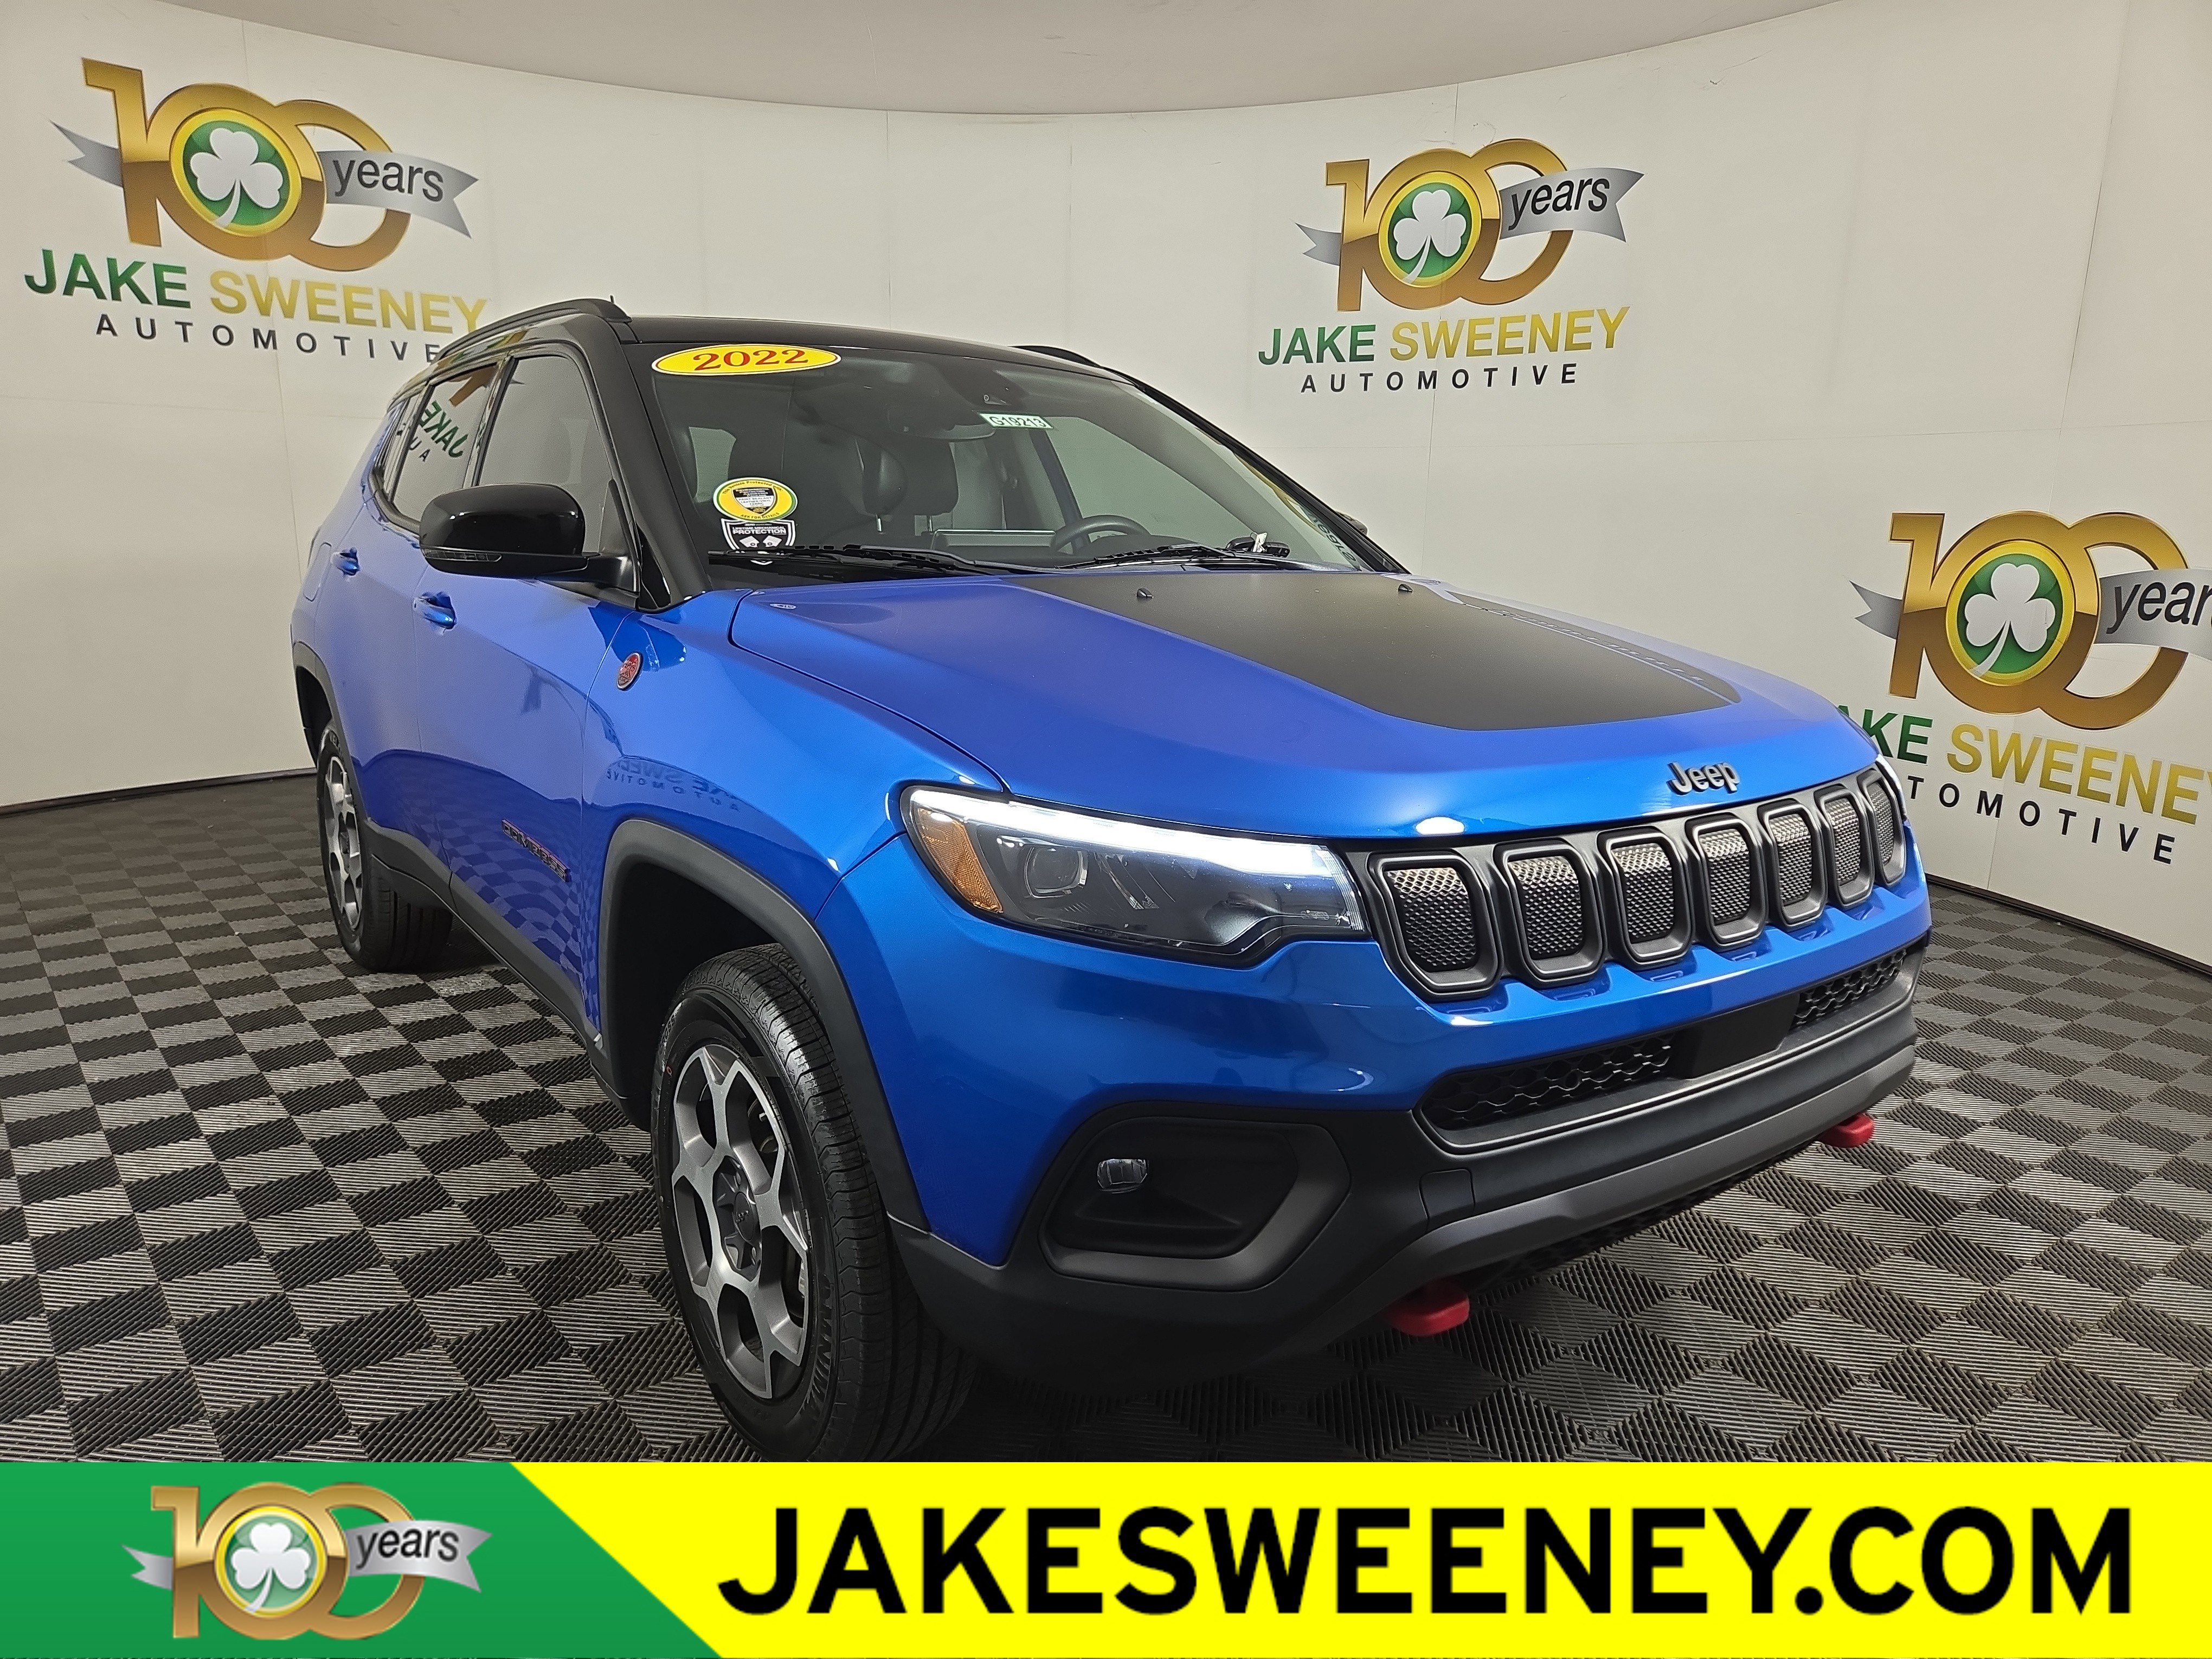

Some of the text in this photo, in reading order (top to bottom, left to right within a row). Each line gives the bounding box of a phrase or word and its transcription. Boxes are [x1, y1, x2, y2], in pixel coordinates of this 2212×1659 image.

[82, 57, 445, 272] 100 years
[1326, 139, 1610, 312] 100 years
[24, 248, 488, 333] JAKE SWEENEY
[96, 314, 440, 364] AUTOMOTIVE
[693, 350, 808, 371] 2022
[1258, 306, 1630, 365] JAKE SWEENEY
[1301, 363, 1578, 394] AUTOMOTIVE
[989, 416, 1047, 427] G19213
[1889, 510, 2212, 730] 100 year
[1666, 761, 1741, 795] Jeep
[1837, 704, 2212, 825] KE SWEENE
[1906, 775, 2176, 865] TOMOTIVE
